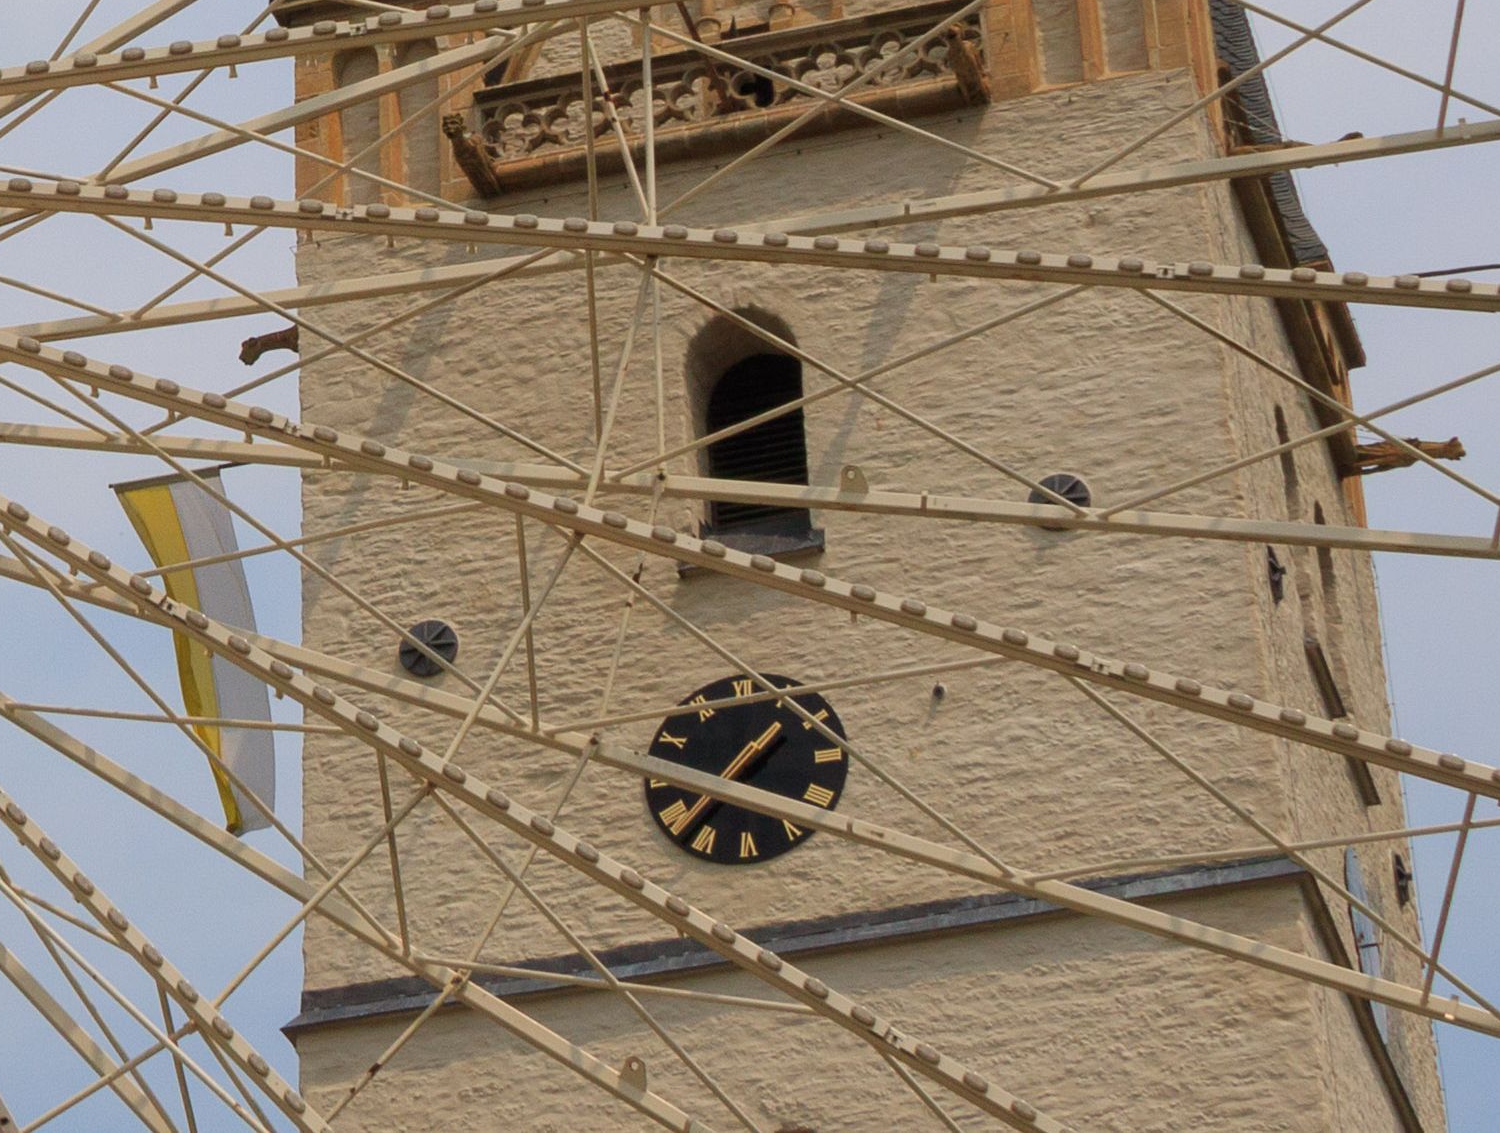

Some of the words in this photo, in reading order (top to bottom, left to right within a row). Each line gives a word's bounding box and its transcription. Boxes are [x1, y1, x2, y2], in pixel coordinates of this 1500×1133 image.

[658, 731, 687, 749] X
[814, 747, 842, 764] III
[803, 782, 834, 808] IIII
[691, 825, 716, 855] VII
[739, 831, 759, 857] VI
